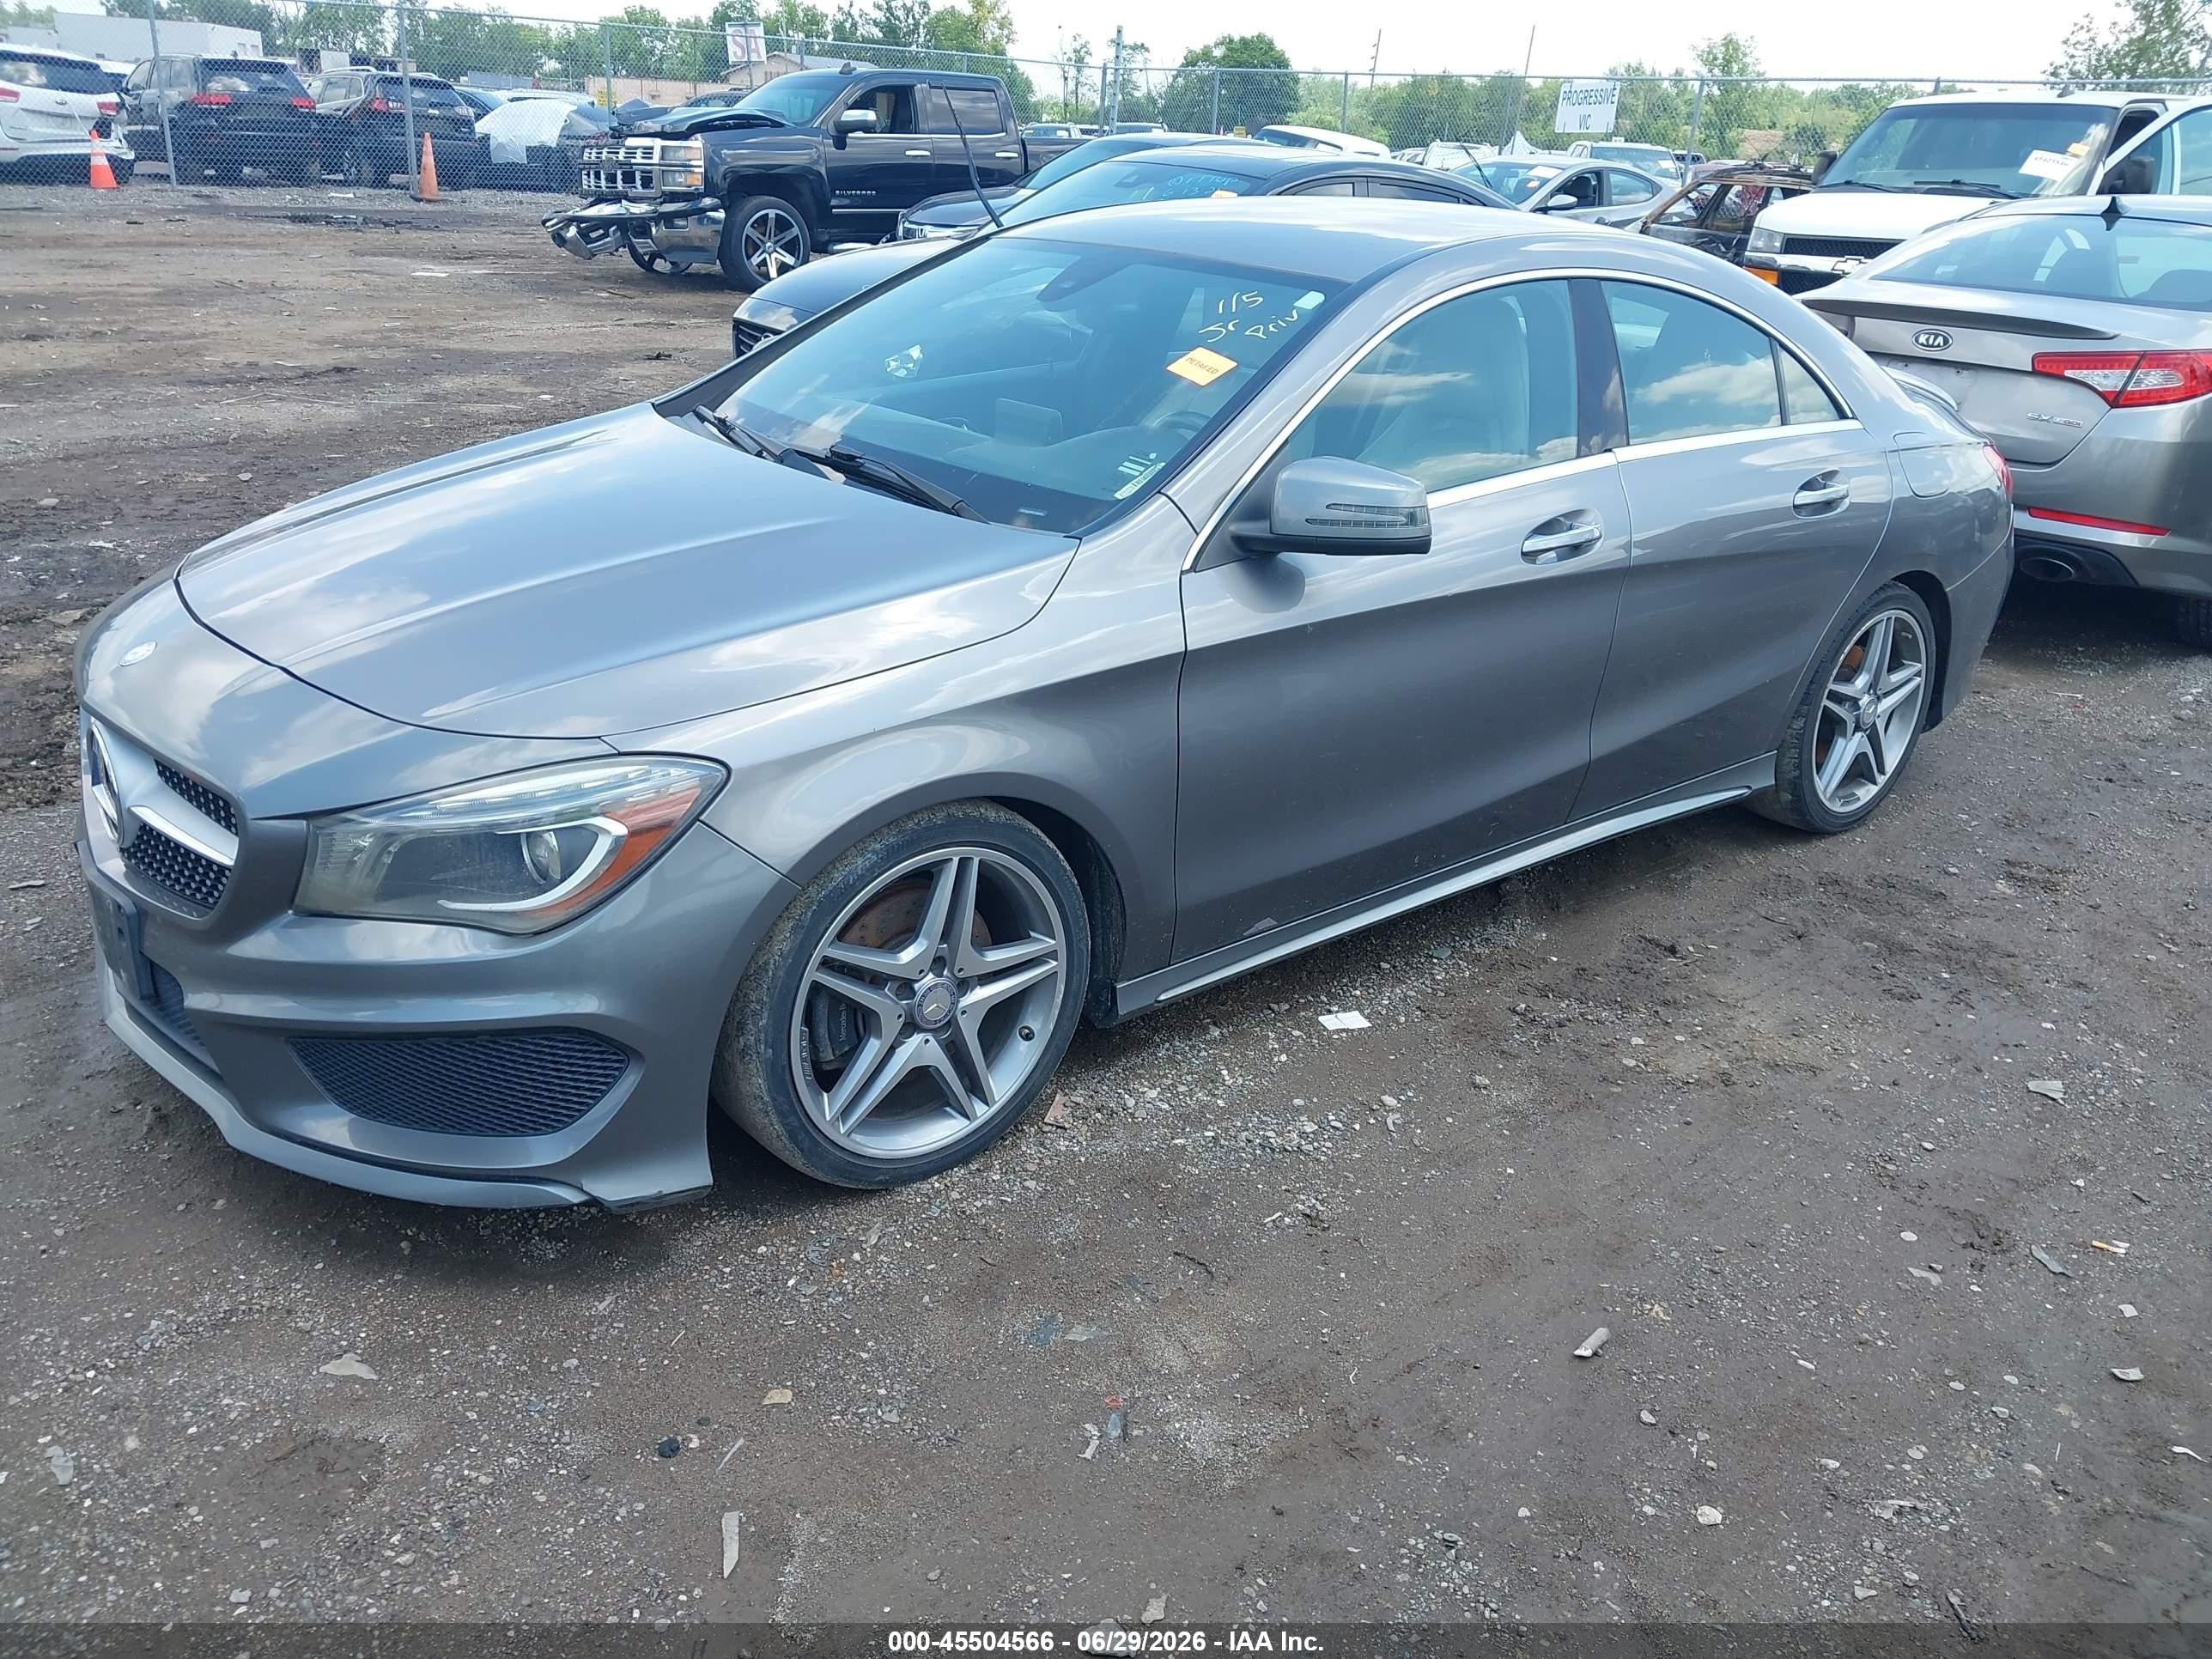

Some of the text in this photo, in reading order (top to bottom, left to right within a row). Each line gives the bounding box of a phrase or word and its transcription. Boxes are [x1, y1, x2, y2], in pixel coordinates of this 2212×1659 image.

[1561, 88, 1617, 106] PROGRESSIVE
[1578, 113, 1591, 131] VIC
[1918, 333, 1944, 347] KIA
